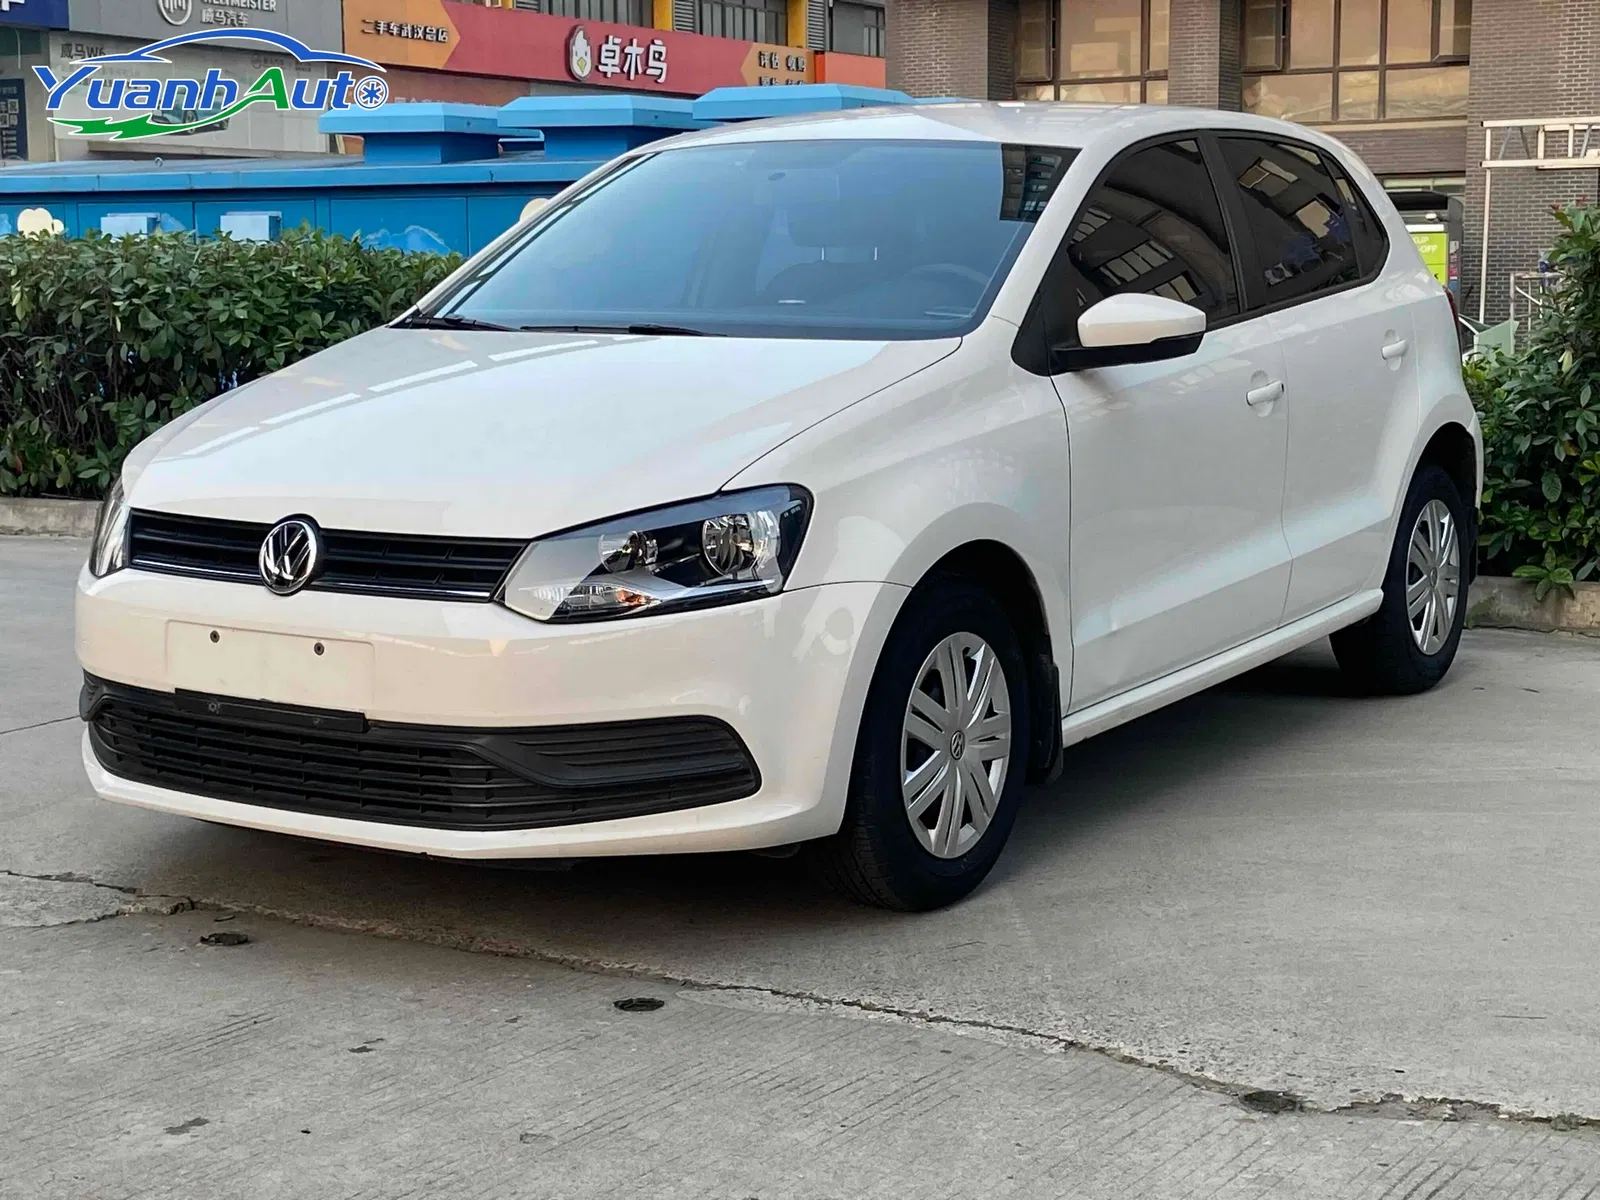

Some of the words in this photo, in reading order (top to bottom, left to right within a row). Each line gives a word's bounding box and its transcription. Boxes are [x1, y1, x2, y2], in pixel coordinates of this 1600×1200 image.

[202, 0, 277, 12] TMEISTER
[361, 19, 449, 43] 二手车武汉总店
[598, 35, 668, 83] 卓木鸟
